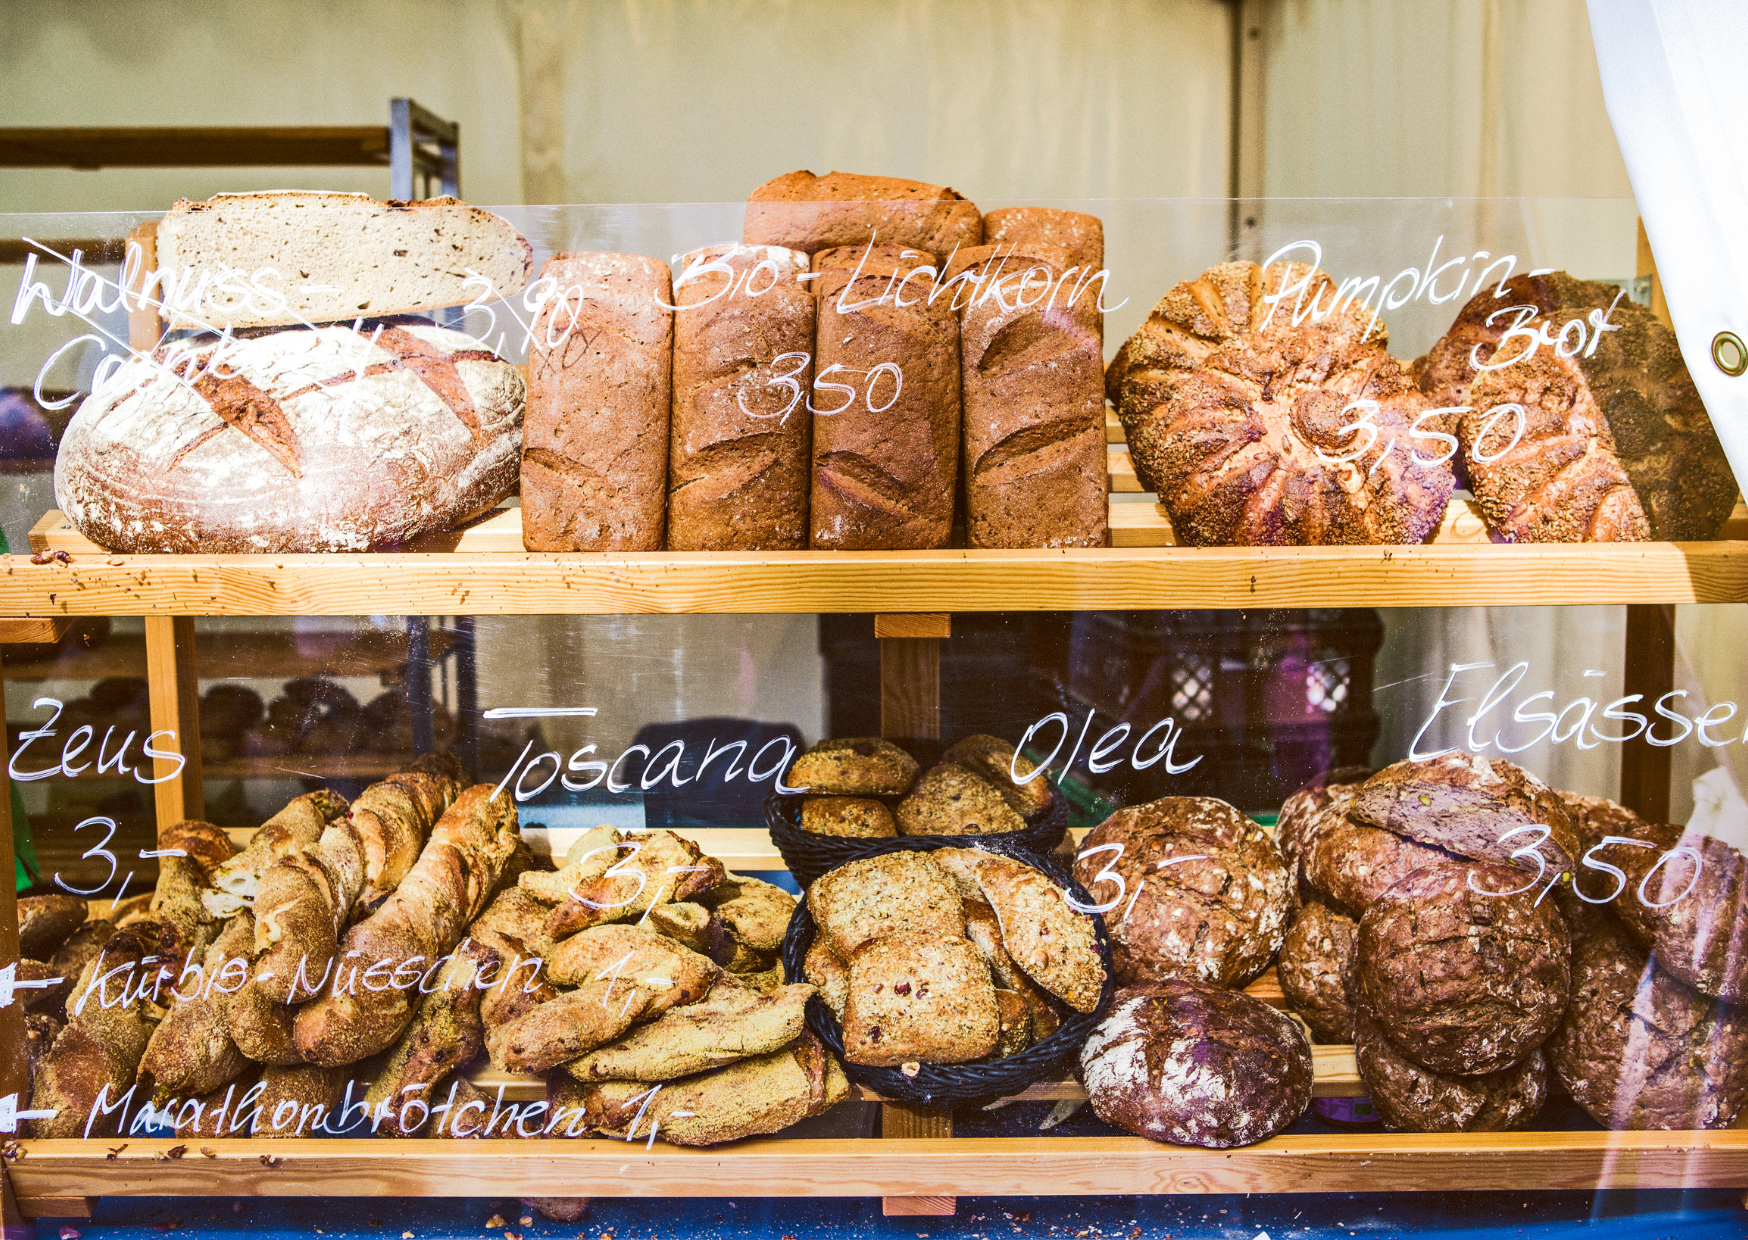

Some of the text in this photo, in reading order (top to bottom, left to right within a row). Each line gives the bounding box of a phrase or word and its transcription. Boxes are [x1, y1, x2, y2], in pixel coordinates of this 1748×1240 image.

[435, 276, 583, 359] 3,90
[1469, 289, 1623, 370] Brot
[738, 352, 902, 426] 3,50
[1315, 401, 1526, 474] 3,50
[8, 698, 186, 784] Zeus
[1011, 708, 1204, 785] Olea
[1409, 660, 1748, 763] Elsässe
[483, 706, 811, 804] Toscana
[54, 817, 188, 910] 3,-
[568, 842, 710, 926] 3,-
[1064, 843, 1207, 921] 3,-
[1467, 824, 1703, 908] 3,50
[84, 1080, 587, 1140] Marathonbrötchen
